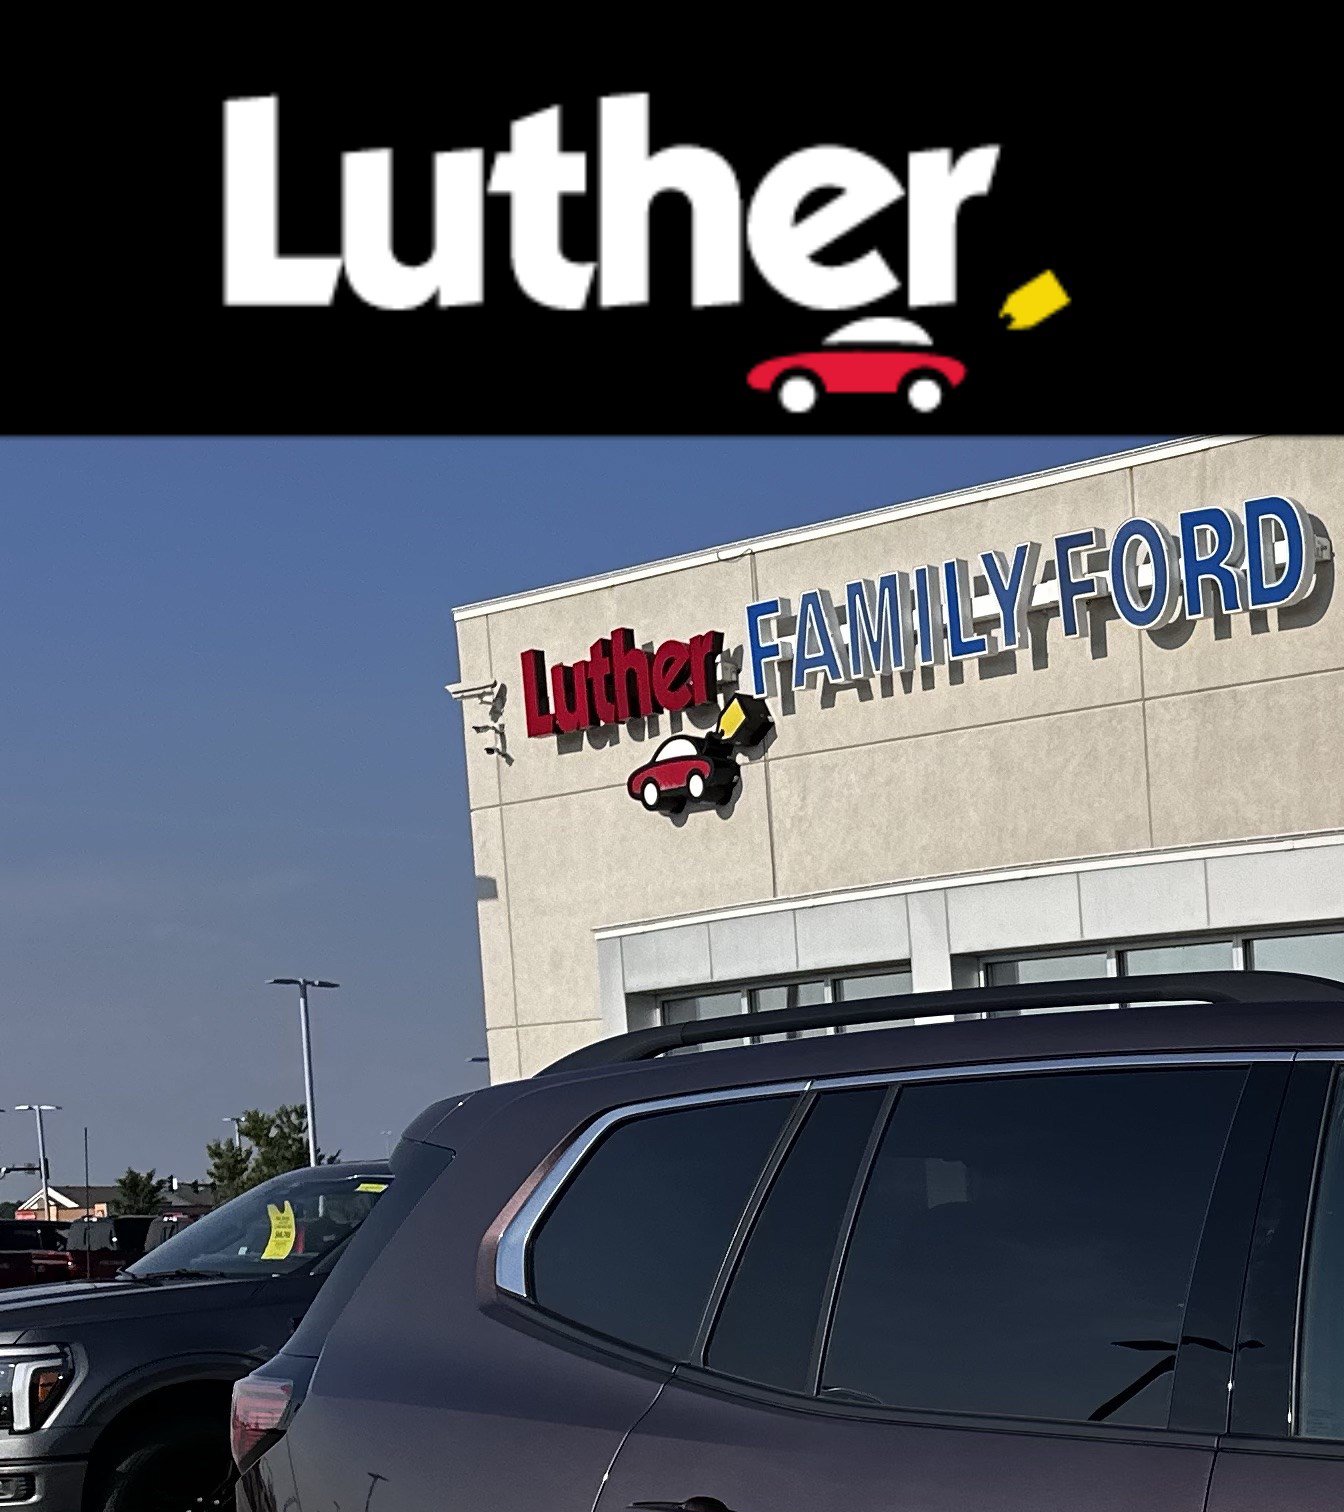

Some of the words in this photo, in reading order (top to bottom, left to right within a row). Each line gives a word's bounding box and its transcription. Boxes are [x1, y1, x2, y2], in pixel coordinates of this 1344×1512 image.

[745, 543, 1031, 698] FAMILY
[1054, 496, 1311, 637] FORD
[521, 628, 722, 738] Luther
